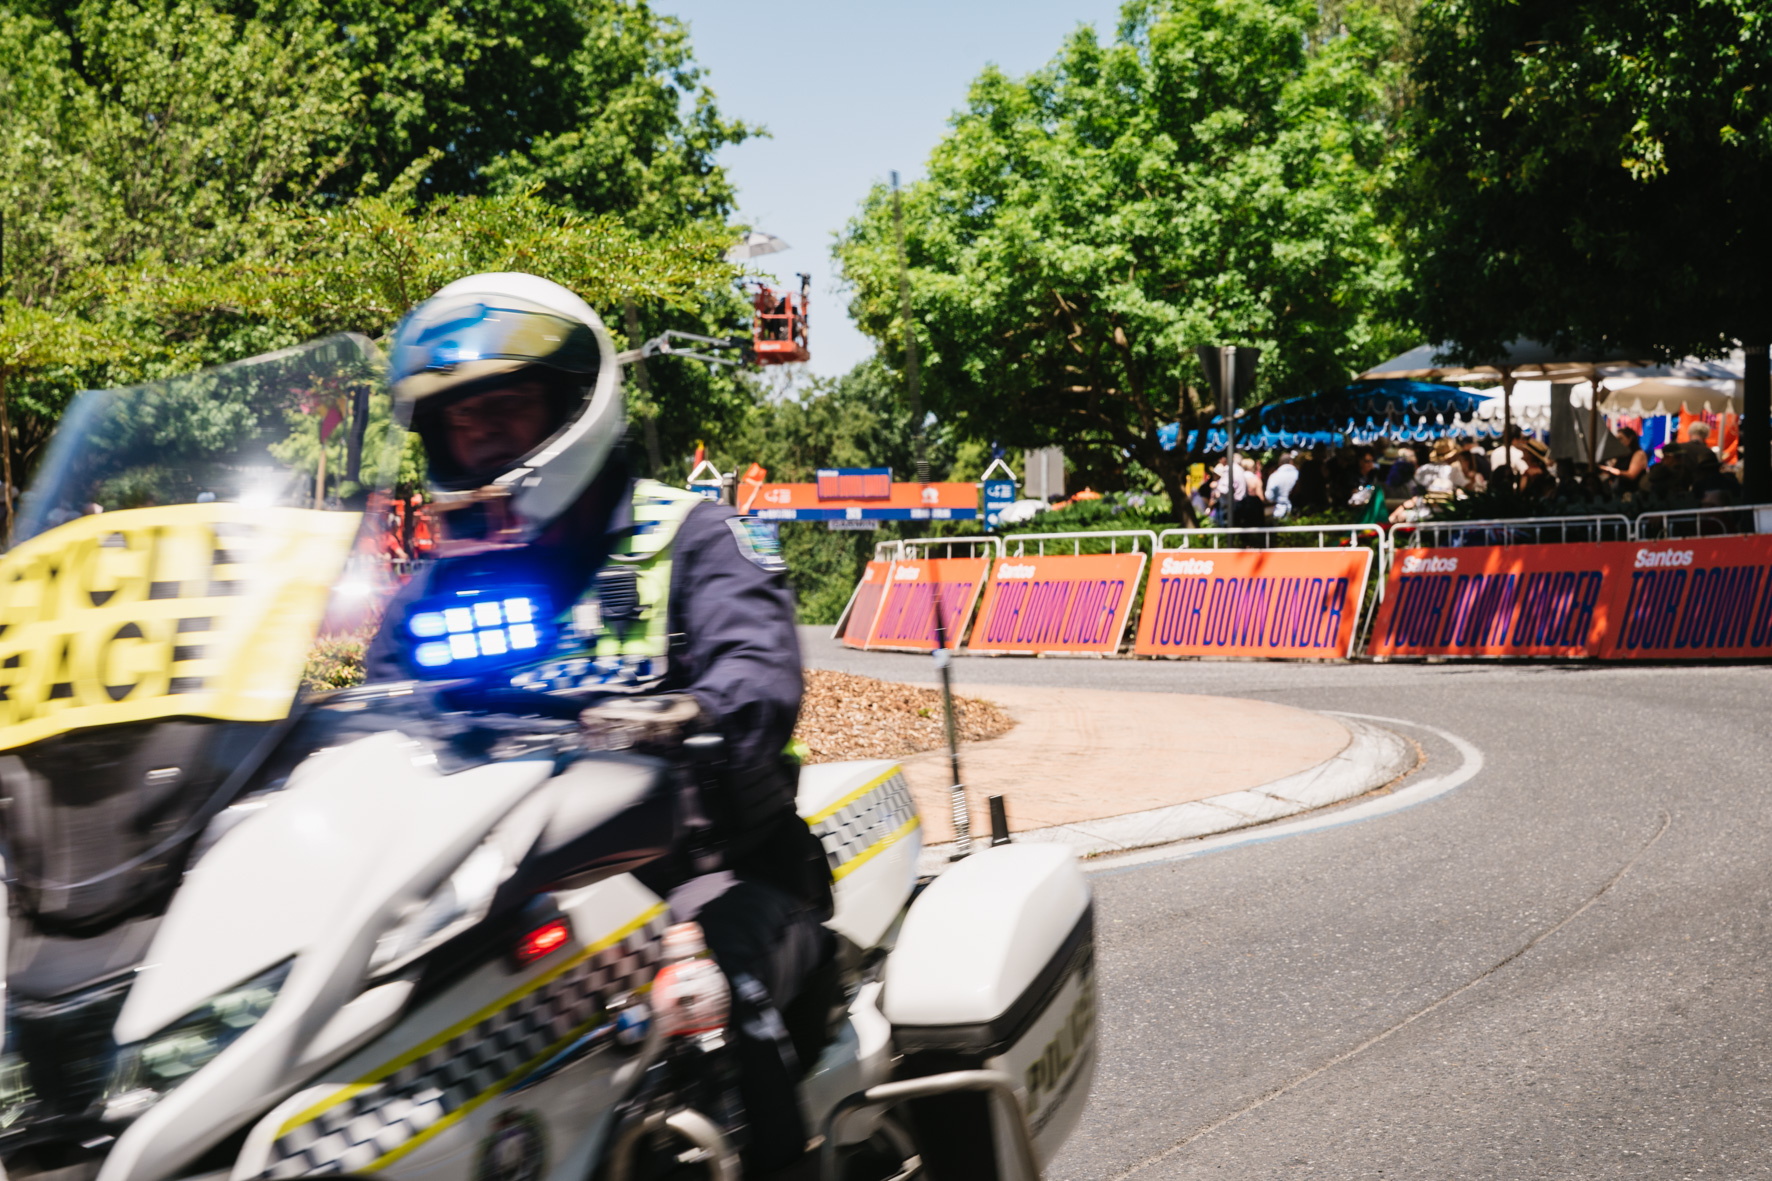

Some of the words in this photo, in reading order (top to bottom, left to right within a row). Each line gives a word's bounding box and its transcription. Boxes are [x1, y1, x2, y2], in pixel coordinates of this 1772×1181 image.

[997, 563, 1036, 579] Santos
[1161, 557, 1214, 575] Santos
[1401, 555, 1458, 573] Santos
[1634, 548, 1694, 568] Santos
[981, 581, 1028, 643] TOUR
[1017, 581, 1075, 643] DOWN
[1063, 581, 1124, 644] UNDER
[1152, 578, 1208, 645] TOUR
[1203, 578, 1276, 646] DOWN
[1270, 578, 1349, 647] UNDER
[1385, 575, 1452, 647] TOUR
[1440, 573, 1525, 647] DOWN
[1512, 571, 1603, 647] UNDER
[1616, 569, 1687, 650] TOUR
[1674, 565, 1764, 648] DOWN
